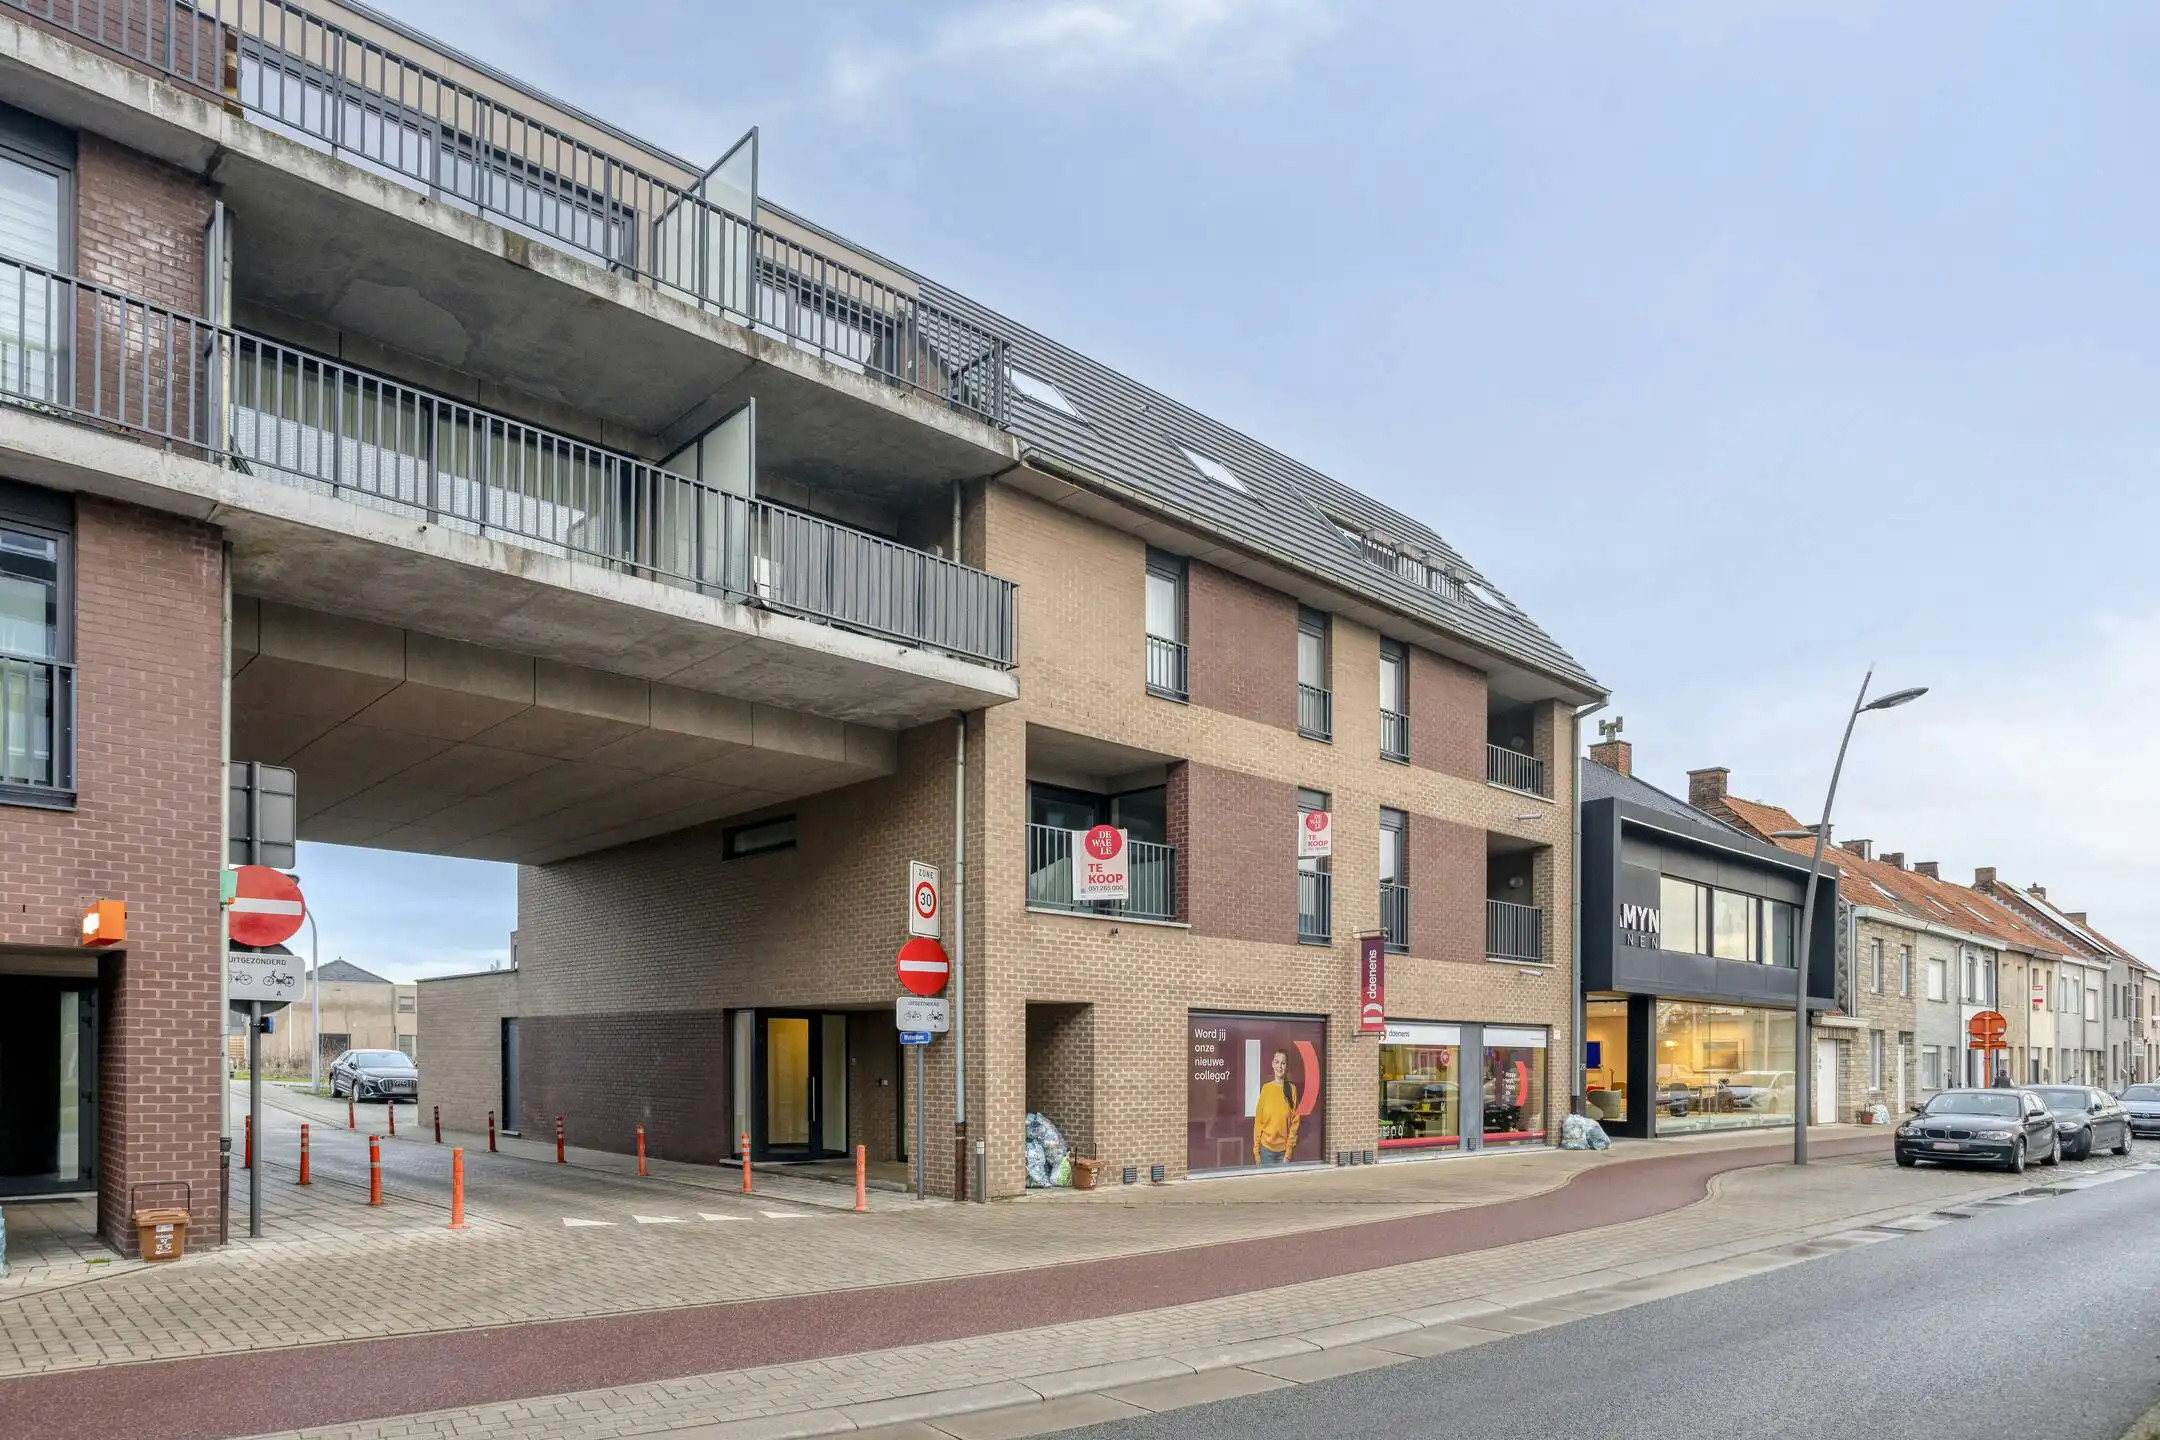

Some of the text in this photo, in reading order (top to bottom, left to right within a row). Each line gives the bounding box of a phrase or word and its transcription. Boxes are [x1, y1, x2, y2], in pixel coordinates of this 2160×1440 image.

[1098, 830, 1112, 839] DE
[1092, 838, 1112, 847] WAE
[1100, 847, 1113, 855] LE
[1087, 863, 1103, 873] TE
[918, 868, 934, 880] ZONE
[1088, 873, 1123, 884] KOOP
[920, 892, 932, 907] 30
[228, 956, 287, 966] UITGEZONDERD
[1367, 949, 1377, 999] daenens
[1194, 1028, 1226, 1042] Word jij
[1388, 1028, 1410, 1038] daenens
[1194, 1044, 1215, 1053] onze
[1194, 1056, 1225, 1067] nieuwe
[1194, 1070, 1230, 1083] collega?
